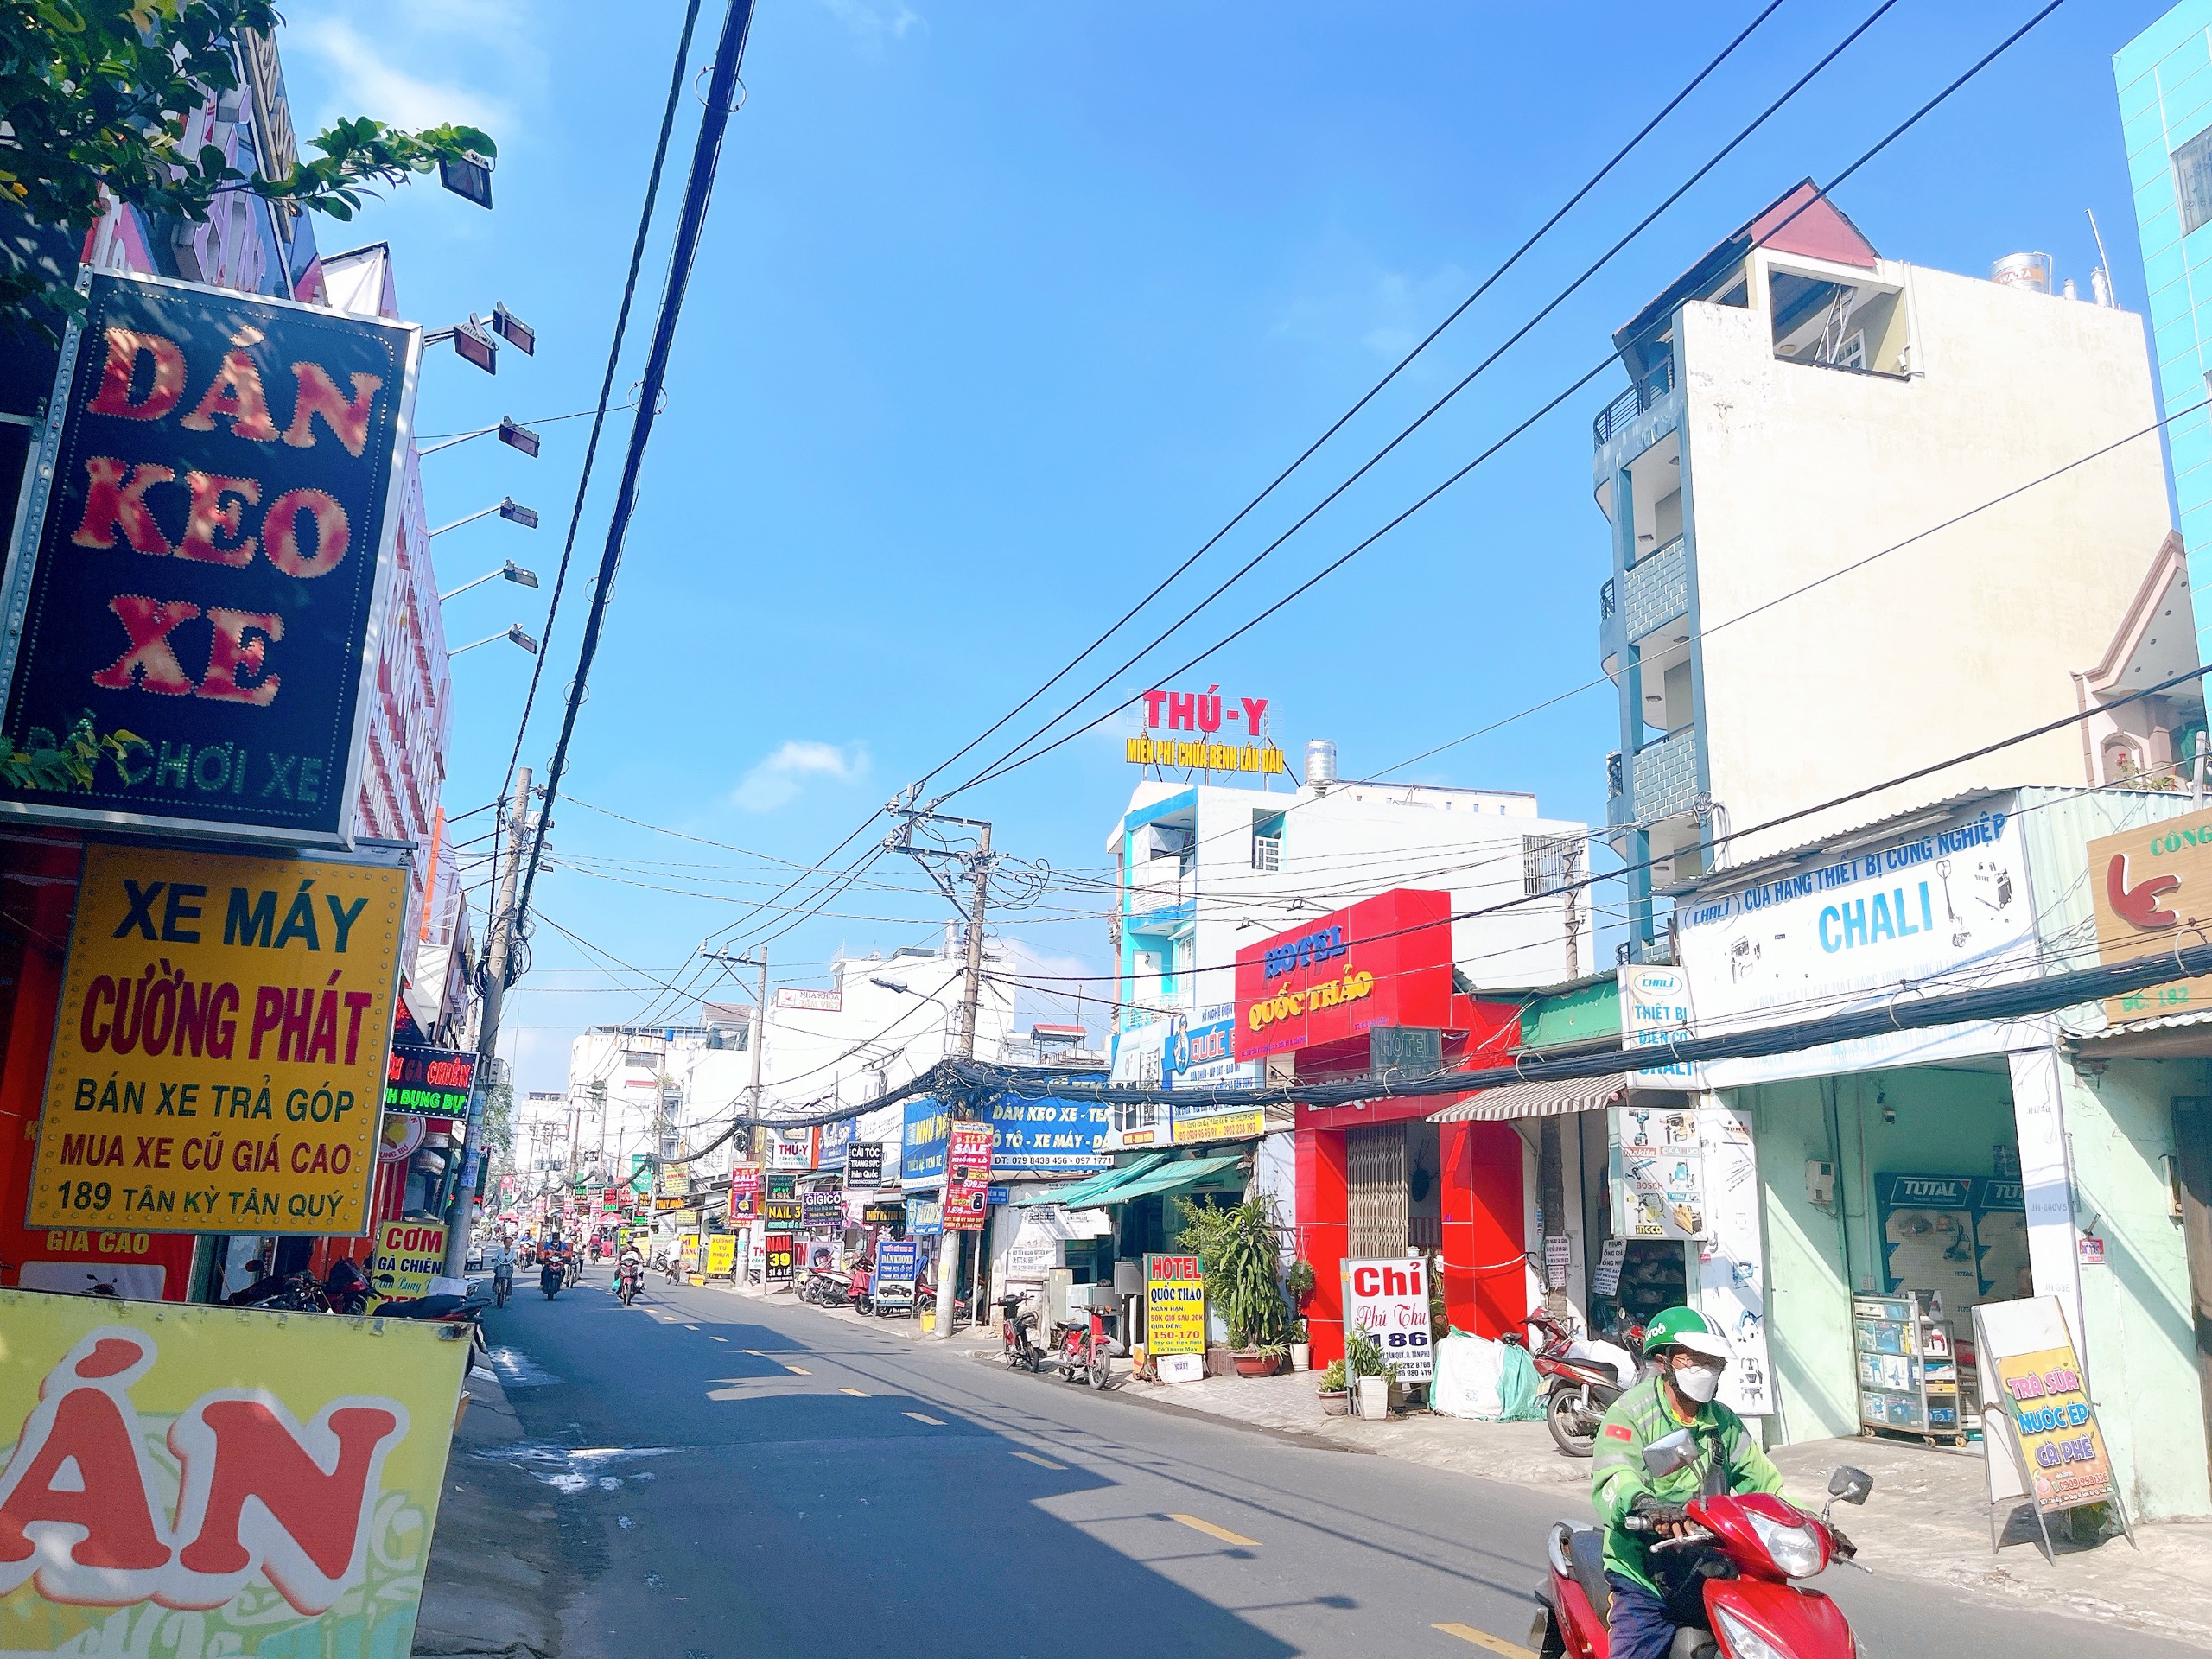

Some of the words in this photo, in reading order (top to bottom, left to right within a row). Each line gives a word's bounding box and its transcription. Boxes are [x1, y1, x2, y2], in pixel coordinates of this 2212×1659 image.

[87, 325, 384, 458] DÁN
[71, 455, 352, 579] KEO
[92, 594, 284, 707] XE
[262, 753, 324, 803] XE
[1775, 874, 1813, 903] HÀNG
[1815, 854, 1859, 893] THIẾT
[1866, 854, 1883, 880] BỊ
[1887, 836, 1933, 869] CÔNG
[1937, 812, 2005, 855] NGHIỆP
[112, 879, 207, 944] XE
[224, 879, 370, 953] MÁY
[1819, 880, 1933, 955] CHALI
[1264, 925, 1347, 979] HOTEL
[1249, 982, 1306, 1032] QUỐC
[1306, 963, 1374, 1012] THẢO
[2158, 987, 2190, 1007] 182
[80, 958, 241, 1060] CƯỜNG
[248, 969, 373, 1065] PHÁT
[1635, 1001, 1669, 1020] THIẾT
[1191, 1025, 1225, 1062] QUỐC
[1380, 1033, 1434, 1058] HOTEL
[74, 1071, 146, 1116] BÁN
[156, 1082, 200, 1117] XE
[212, 1074, 271, 1121] TRẢ
[286, 1080, 356, 1123] GÓP
[400, 1090, 441, 1109] BỤNG
[992, 1103, 1024, 1121] DÁN
[1027, 1107, 1057, 1122] KEO
[1058, 1107, 1079, 1122] XE
[851, 1145, 864, 1157] CÀI
[865, 1144, 880, 1157] TÓC
[954, 1144, 988, 1155] SALE
[993, 1130, 1002, 1147] Ô
[1006, 1130, 1023, 1148] TÔ
[1033, 1134, 1052, 1148] XE
[1052, 1130, 1084, 1148] MÁY
[60, 1133, 124, 1166] MUA
[133, 1136, 175, 1169] XE
[182, 1131, 226, 1172] CŨ
[232, 1133, 281, 1173] GIÁ
[291, 1142, 352, 1176] CAO
[58, 1180, 111, 1211] 189
[122, 1184, 175, 1213] TÂN
[183, 1185, 219, 1214] KỲ
[228, 1187, 281, 1217] TÂN
[288, 1189, 345, 1218] QUÝ
[806, 1193, 841, 1205] GIGICO
[1904, 1181, 1957, 1197] TOTAL
[768, 1206, 791, 1218] NAIL
[98, 1232, 150, 1255] CAO
[386, 1227, 444, 1253] CƠM
[766, 1236, 792, 1251] NAIL
[378, 1254, 396, 1271] GÀ
[400, 1256, 443, 1274] CHIÊN
[770, 1253, 791, 1267] 39
[1151, 1256, 1202, 1280] HOTEL
[1354, 1262, 1421, 1297] Chỉ
[1151, 1282, 1176, 1303] QUỐC
[1178, 1282, 1202, 1300] THẢO
[1355, 1305, 1387, 1327] Phú
[1368, 1332, 1428, 1347] 186
[2007, 1371, 2044, 1400] TRÀ
[2044, 1368, 2080, 1394] SỮA
[2017, 1404, 2067, 1434] NƯỚC
[2066, 1400, 2089, 1426] ÉP
[2036, 1440, 2060, 1466] CÀ
[2060, 1433, 2094, 1463] PHÊ
[2059, 1478, 2079, 1491] 0909
[2079, 1475, 2094, 1486] 998
[2094, 1472, 2109, 1484] 336
